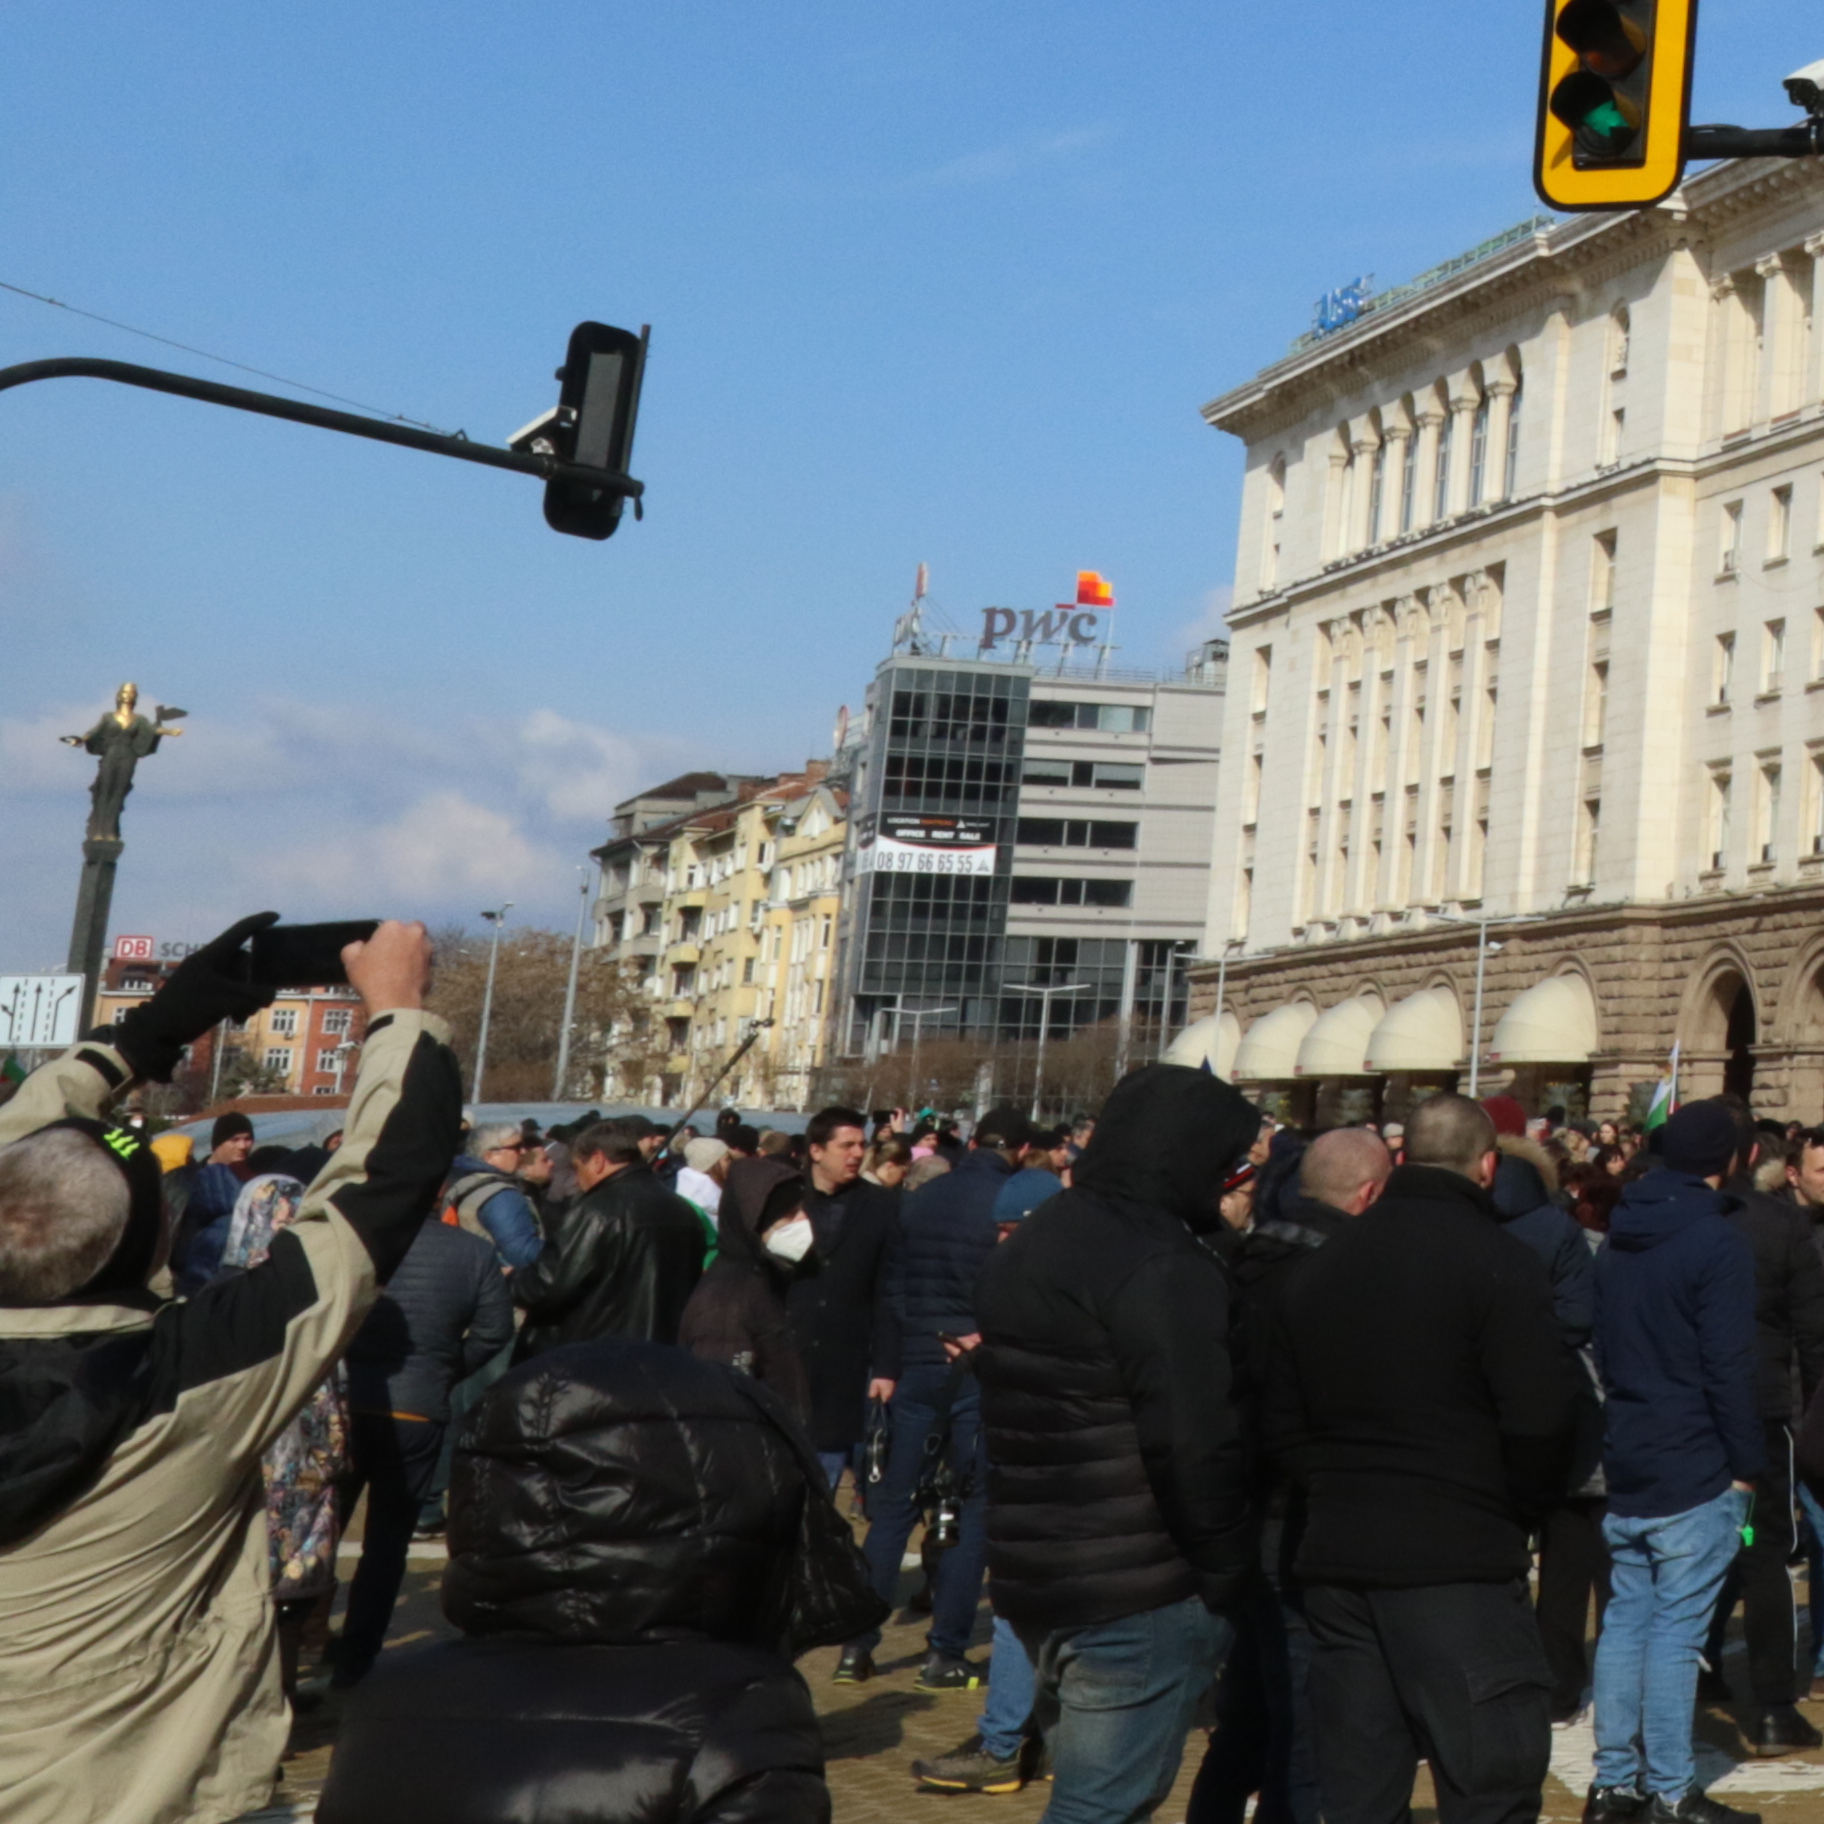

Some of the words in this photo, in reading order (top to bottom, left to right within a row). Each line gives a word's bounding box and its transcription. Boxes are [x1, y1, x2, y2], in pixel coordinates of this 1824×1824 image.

[981, 606, 1098, 649] pwc
[877, 852, 894, 870] 08
[898, 852, 913, 871] 97
[917, 853, 933, 872] 66
[937, 854, 953, 872] 65
[957, 855, 973, 873] 55
[120, 940, 148, 956] DB
